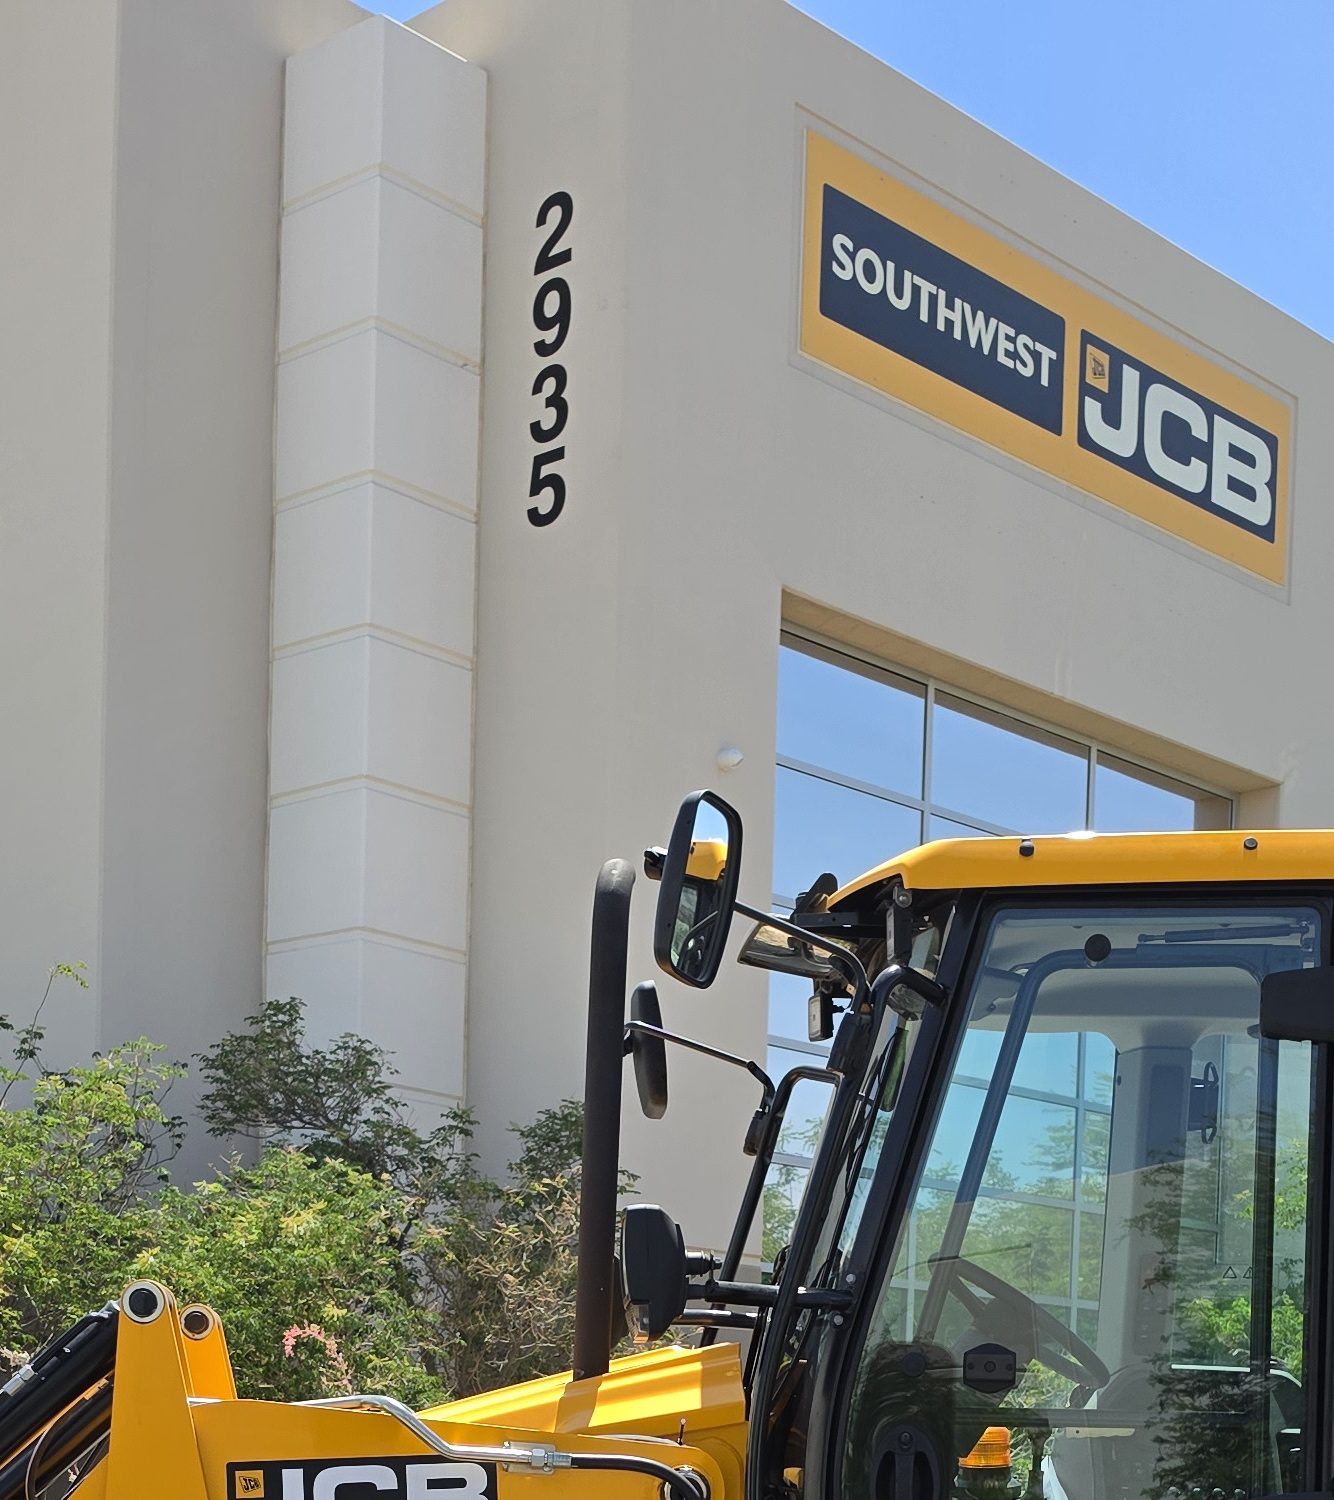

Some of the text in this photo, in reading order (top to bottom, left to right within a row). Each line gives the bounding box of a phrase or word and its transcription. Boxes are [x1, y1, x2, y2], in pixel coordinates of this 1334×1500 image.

[527, 191, 574, 528] 2935
[831, 233, 1057, 388] SOUTHWEST
[1083, 363, 1273, 527] JCB
